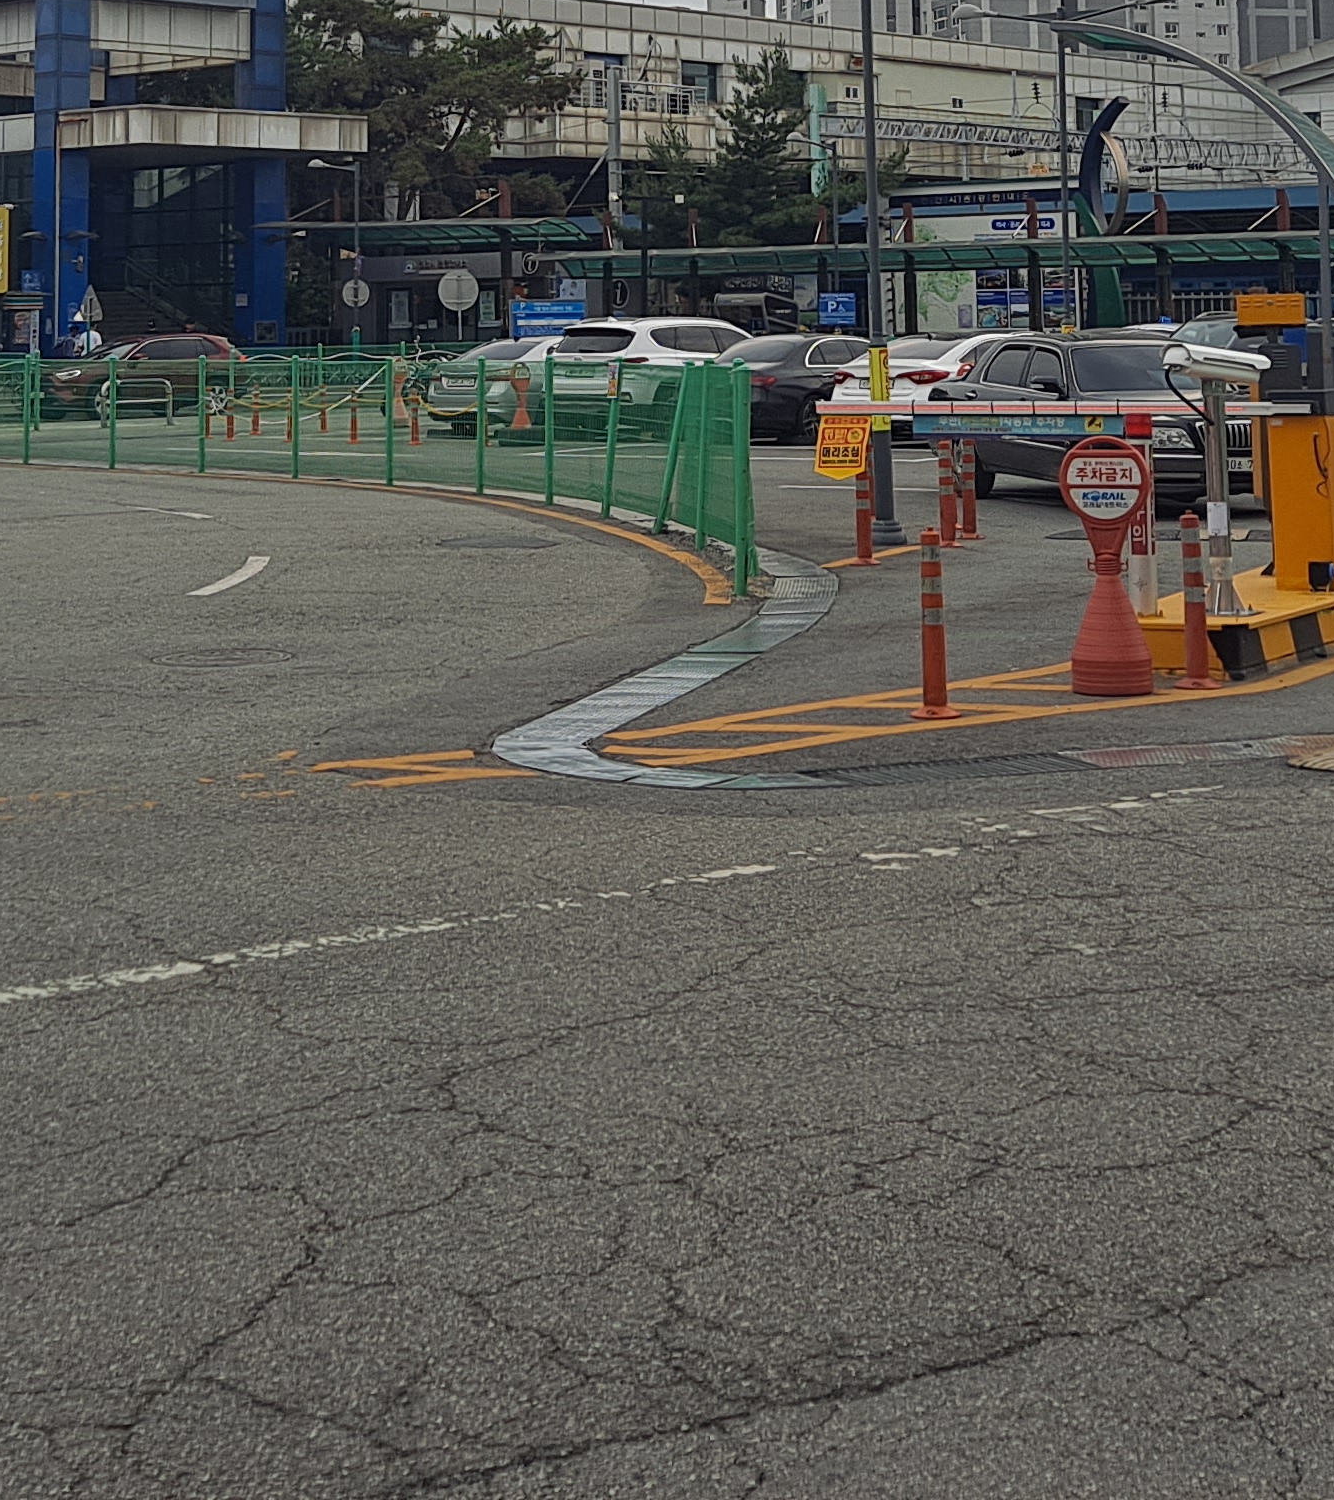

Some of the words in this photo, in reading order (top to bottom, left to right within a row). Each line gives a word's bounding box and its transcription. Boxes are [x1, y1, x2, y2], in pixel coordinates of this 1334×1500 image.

[822, 445, 860, 458] 머리조심
[1075, 467, 1133, 482] 주차금지
[1082, 490, 1126, 502] KORAIL
